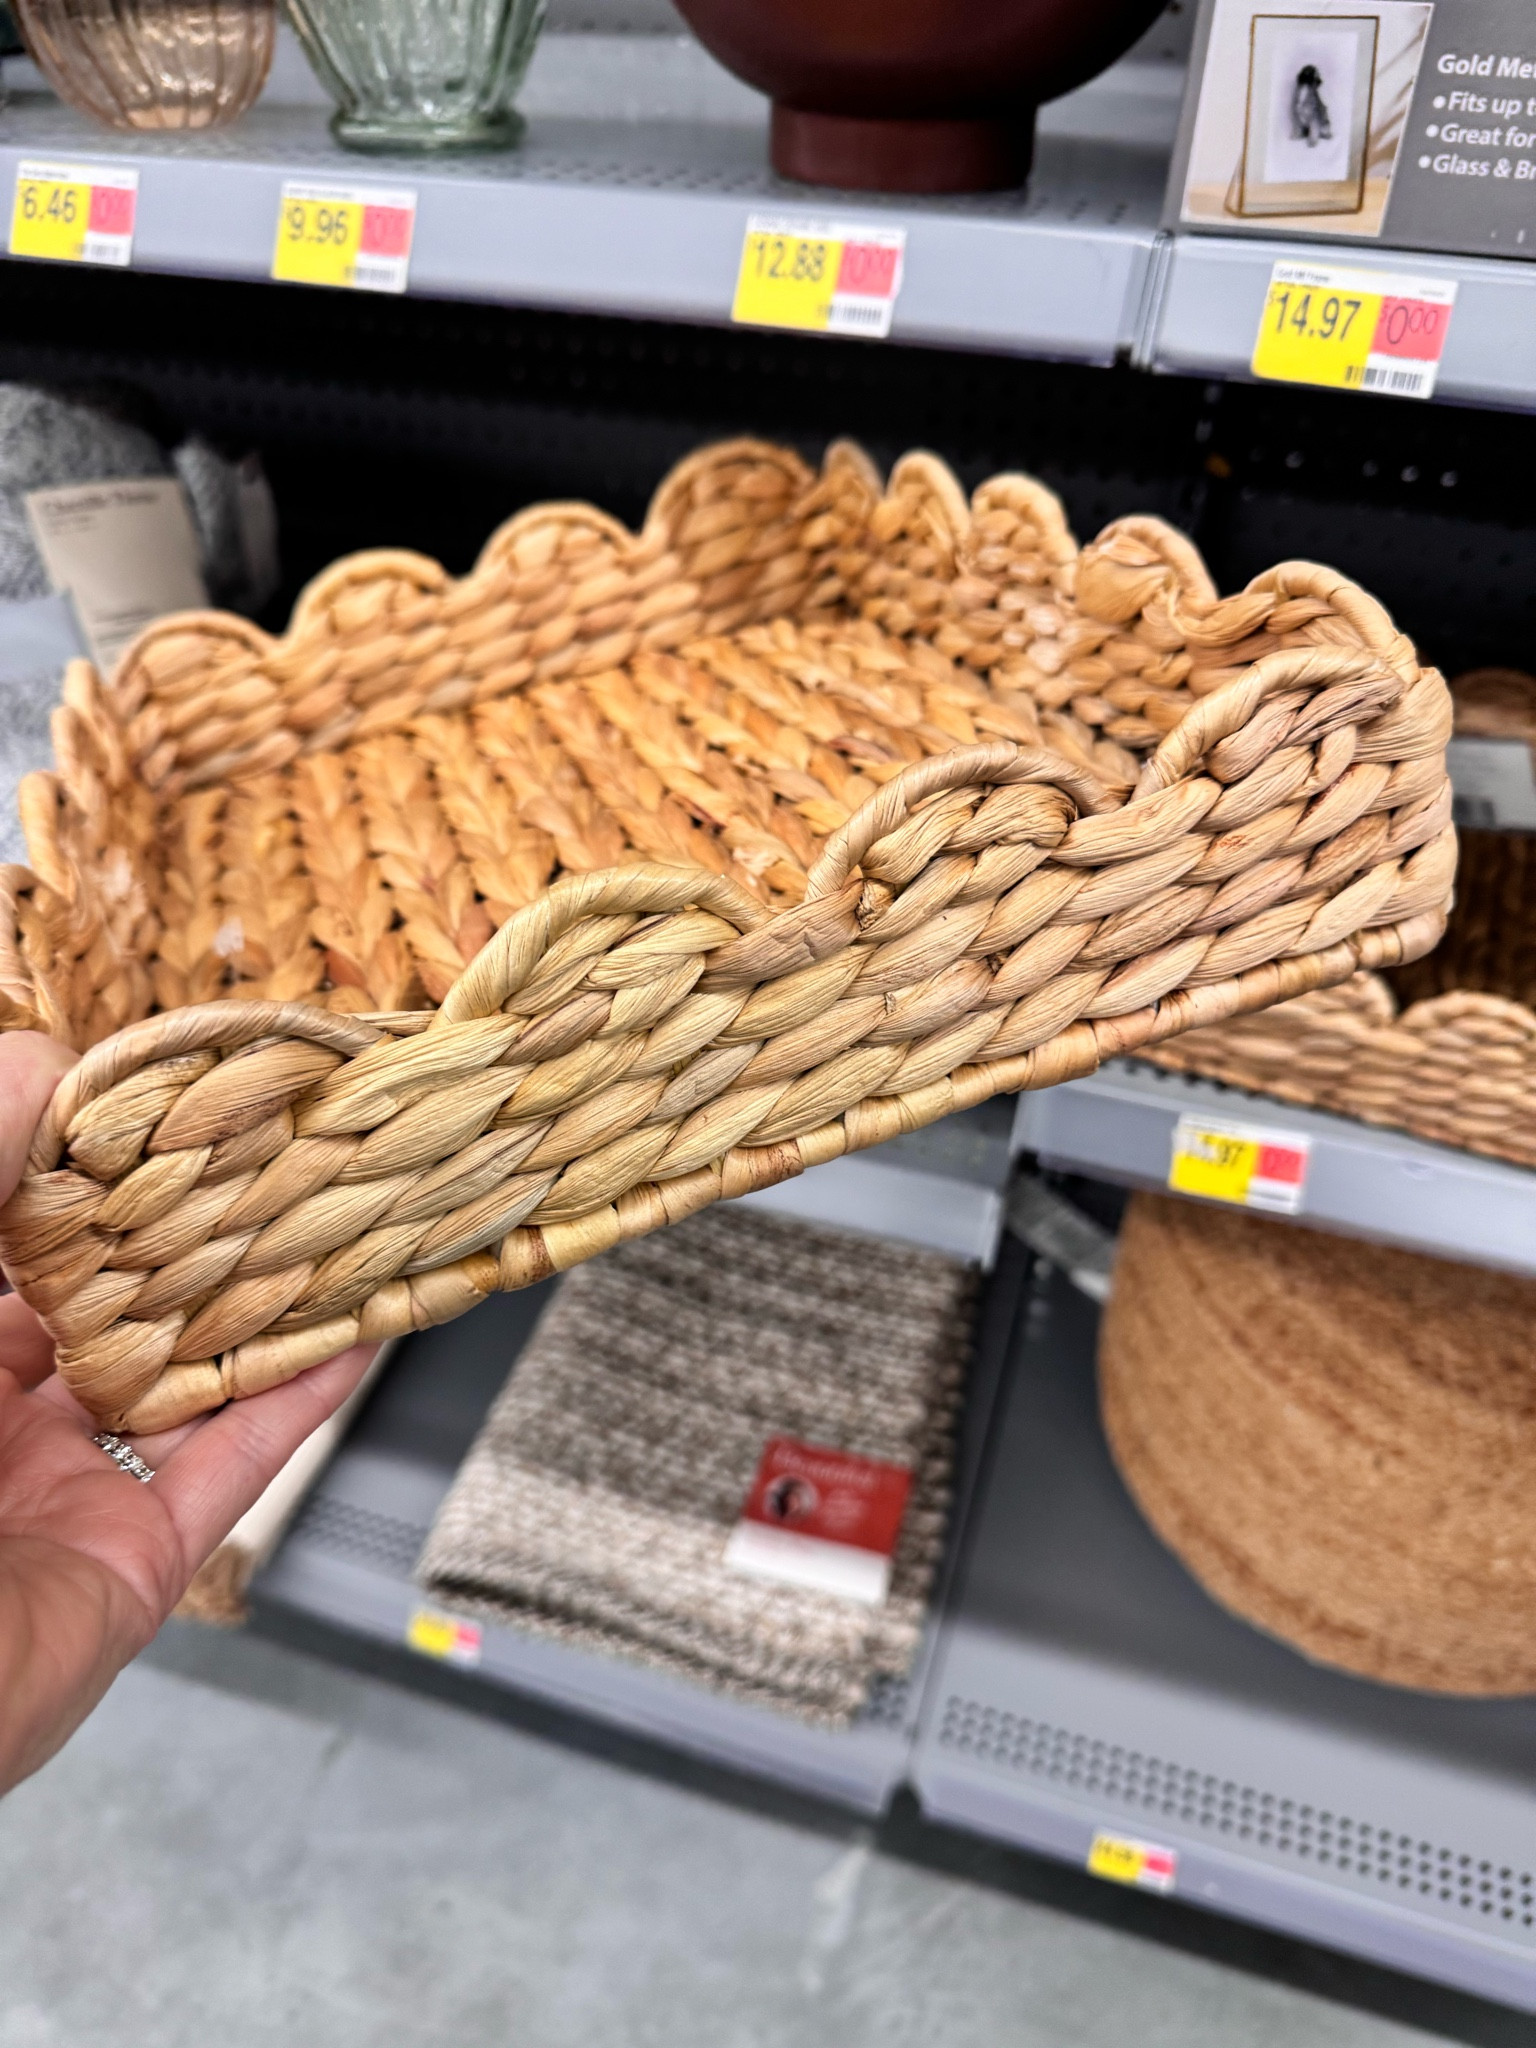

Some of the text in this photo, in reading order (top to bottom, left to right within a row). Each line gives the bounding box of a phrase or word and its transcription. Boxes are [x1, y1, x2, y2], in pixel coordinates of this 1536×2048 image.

[1437, 53, 1494, 76] Gold
[1448, 91, 1536, 119] Fits up t
[1440, 122, 1536, 148] Great for
[1432, 153, 1490, 176] Glass
[1493, 157, 1511, 178] &
